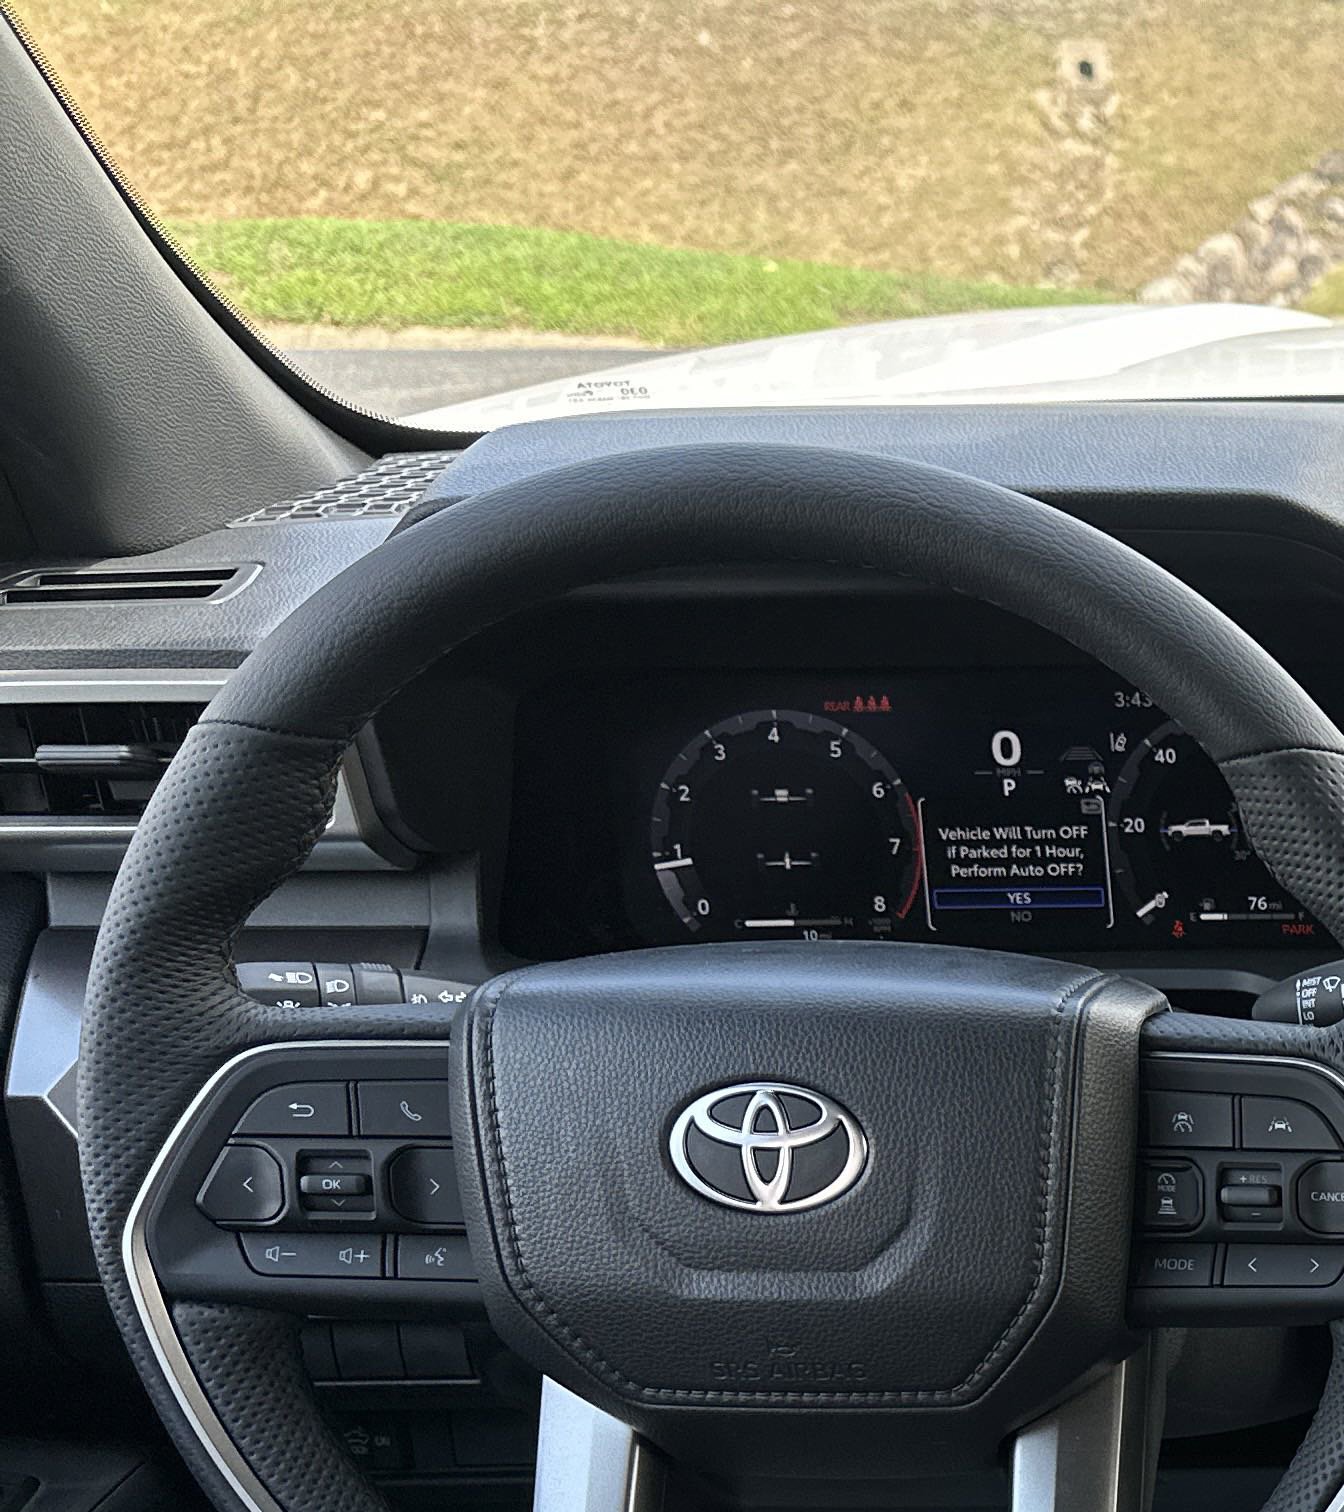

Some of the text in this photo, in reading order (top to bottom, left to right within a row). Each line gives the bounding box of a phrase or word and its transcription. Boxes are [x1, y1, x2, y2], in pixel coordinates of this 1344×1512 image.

[768, 727, 780, 743] 4
[714, 744, 726, 761] 3
[830, 740, 842, 758] 5
[991, 730, 1022, 767] 0
[1154, 748, 1177, 764] 40
[678, 785, 690, 802] 2
[872, 782, 885, 799] 6
[1003, 779, 1016, 797] P
[938, 826, 1088, 841] Vehicle Will Turn OFF
[1123, 817, 1146, 834] 20
[888, 838, 900, 855] 7
[959, 846, 1008, 859] Parked
[1011, 846, 1032, 858] for
[1045, 846, 1085, 860] Hour,
[951, 863, 1084, 878] Perform Auto OFF?
[873, 896, 886, 912] 8
[1007, 892, 1032, 904] YES
[1248, 896, 1268, 910] 76
[697, 899, 709, 915] 0
[1010, 911, 1032, 923] NO
[1282, 924, 1314, 935] PARK
[1302, 988, 1317, 998] OFF
[1303, 1011, 1315, 1021] LO
[322, 1179, 341, 1190] OK
[1154, 1258, 1195, 1271] MODE
